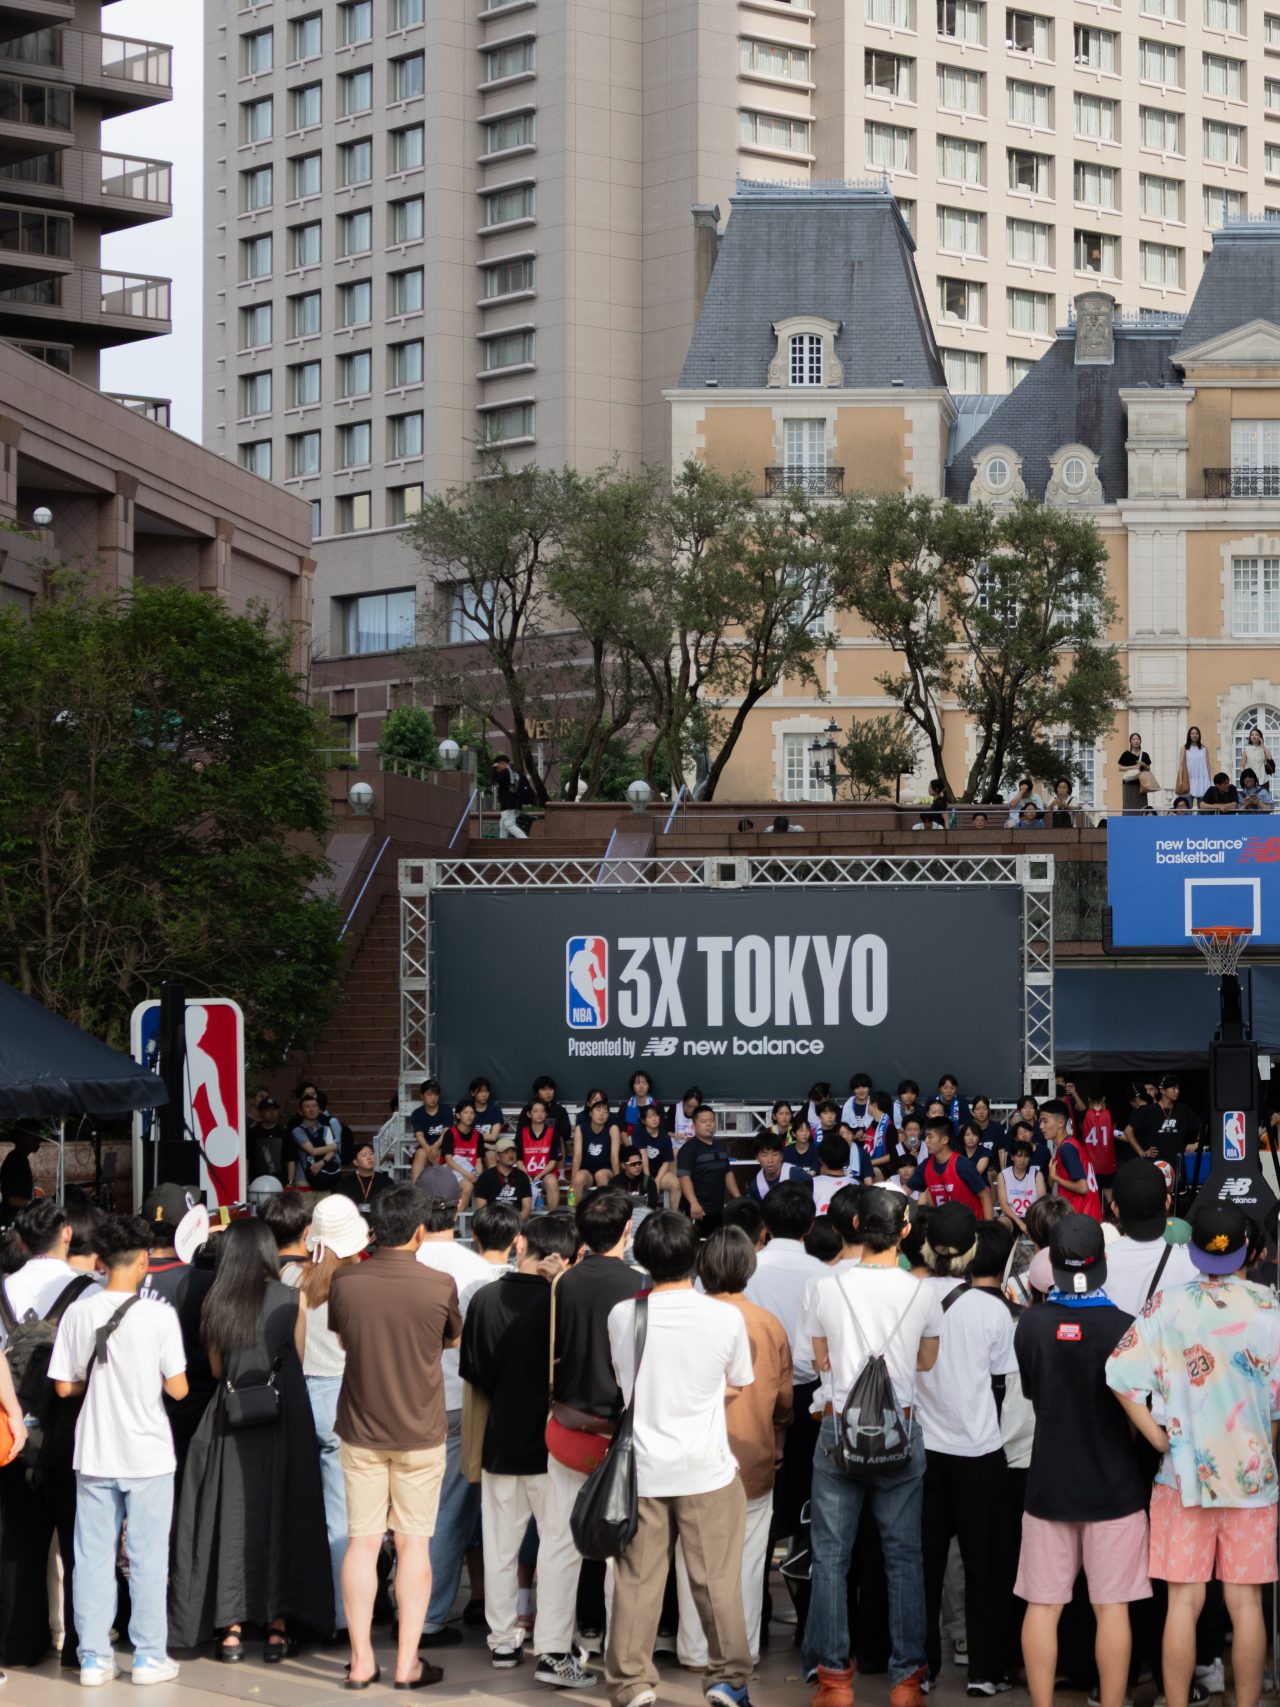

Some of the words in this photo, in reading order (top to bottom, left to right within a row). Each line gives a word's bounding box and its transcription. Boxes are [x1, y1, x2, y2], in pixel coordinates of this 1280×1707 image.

[1157, 840, 1183, 850] new
[1156, 851, 1225, 864] basketball
[617, 936, 687, 1029] 3X
[696, 934, 888, 1028] TOKYO
[572, 1007, 593, 1023] NBA
[568, 1037, 621, 1057] Presented
[622, 1037, 636, 1059] by
[683, 1040, 729, 1056] new
[733, 1036, 825, 1056] balance
[1085, 1125, 1108, 1146] 41
[527, 1156, 546, 1172] 64
[1232, 1196, 1258, 1204] alance
[1189, 1355, 1210, 1377] 23
